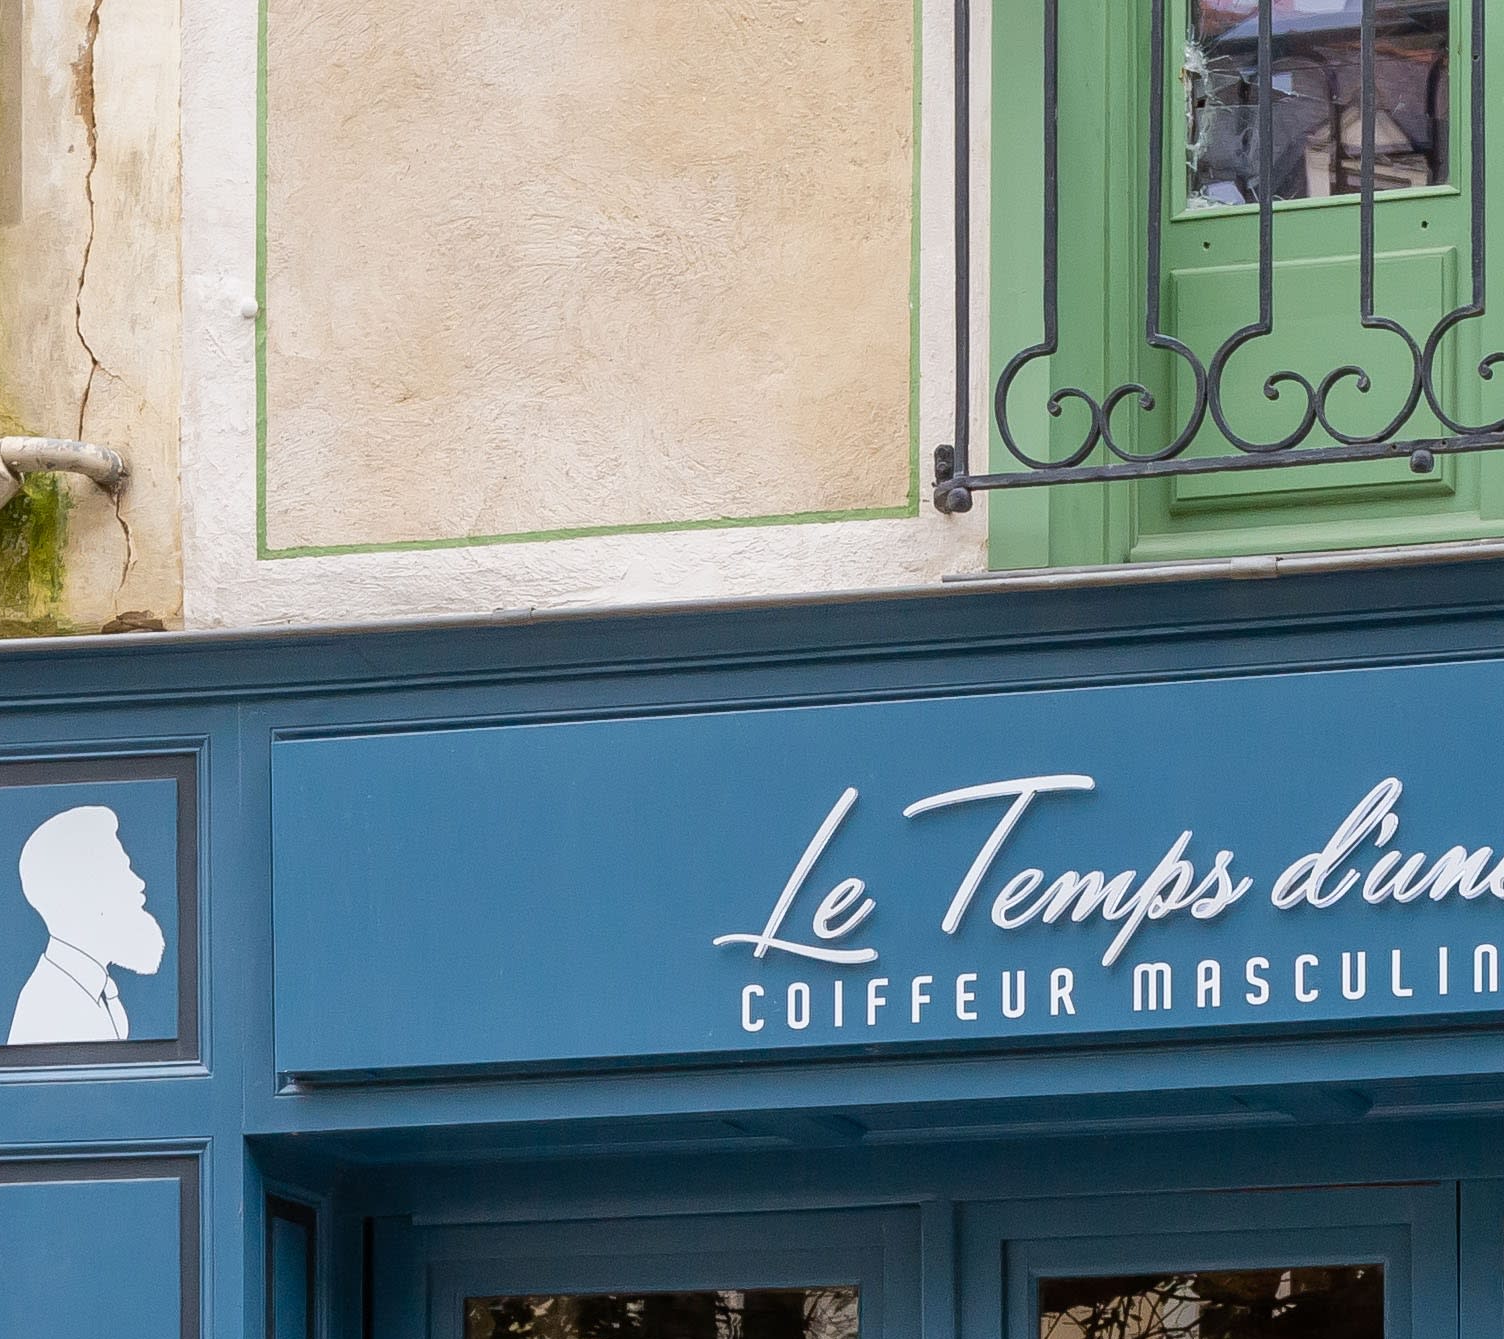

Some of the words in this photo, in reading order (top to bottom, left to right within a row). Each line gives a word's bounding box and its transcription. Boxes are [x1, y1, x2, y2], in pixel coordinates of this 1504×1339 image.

[714, 787, 878, 965] Le
[904, 775, 1251, 967] Temps
[740, 968, 1077, 1033] COIFFEUR
[1133, 944, 1498, 1012] MASCULIN
